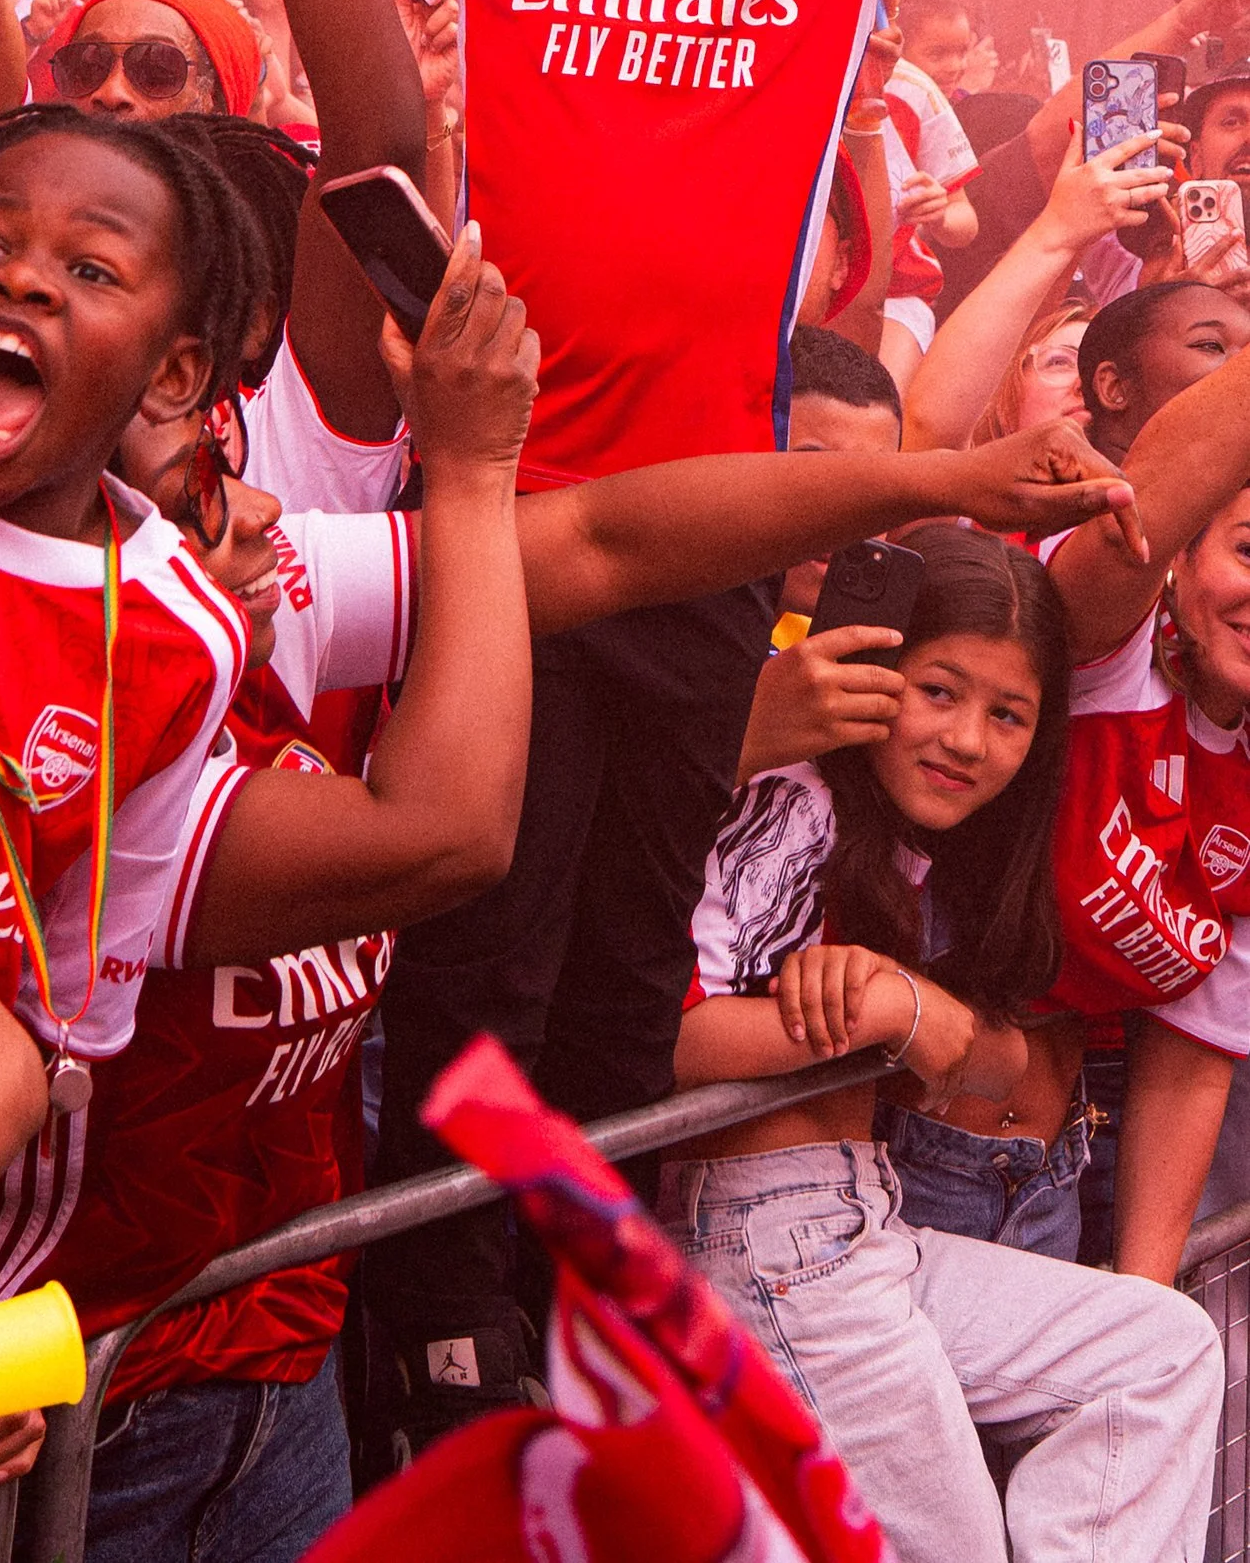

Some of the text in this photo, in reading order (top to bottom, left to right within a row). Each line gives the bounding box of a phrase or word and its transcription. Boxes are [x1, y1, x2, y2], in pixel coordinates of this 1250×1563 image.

[541, 23, 756, 89] FLY BETTER
[43, 719, 97, 758] Arsenal
[1211, 834, 1246, 859] Arsenal
[1080, 876, 1198, 994] FLY BETTER
[246, 1027, 326, 1109] FLY
